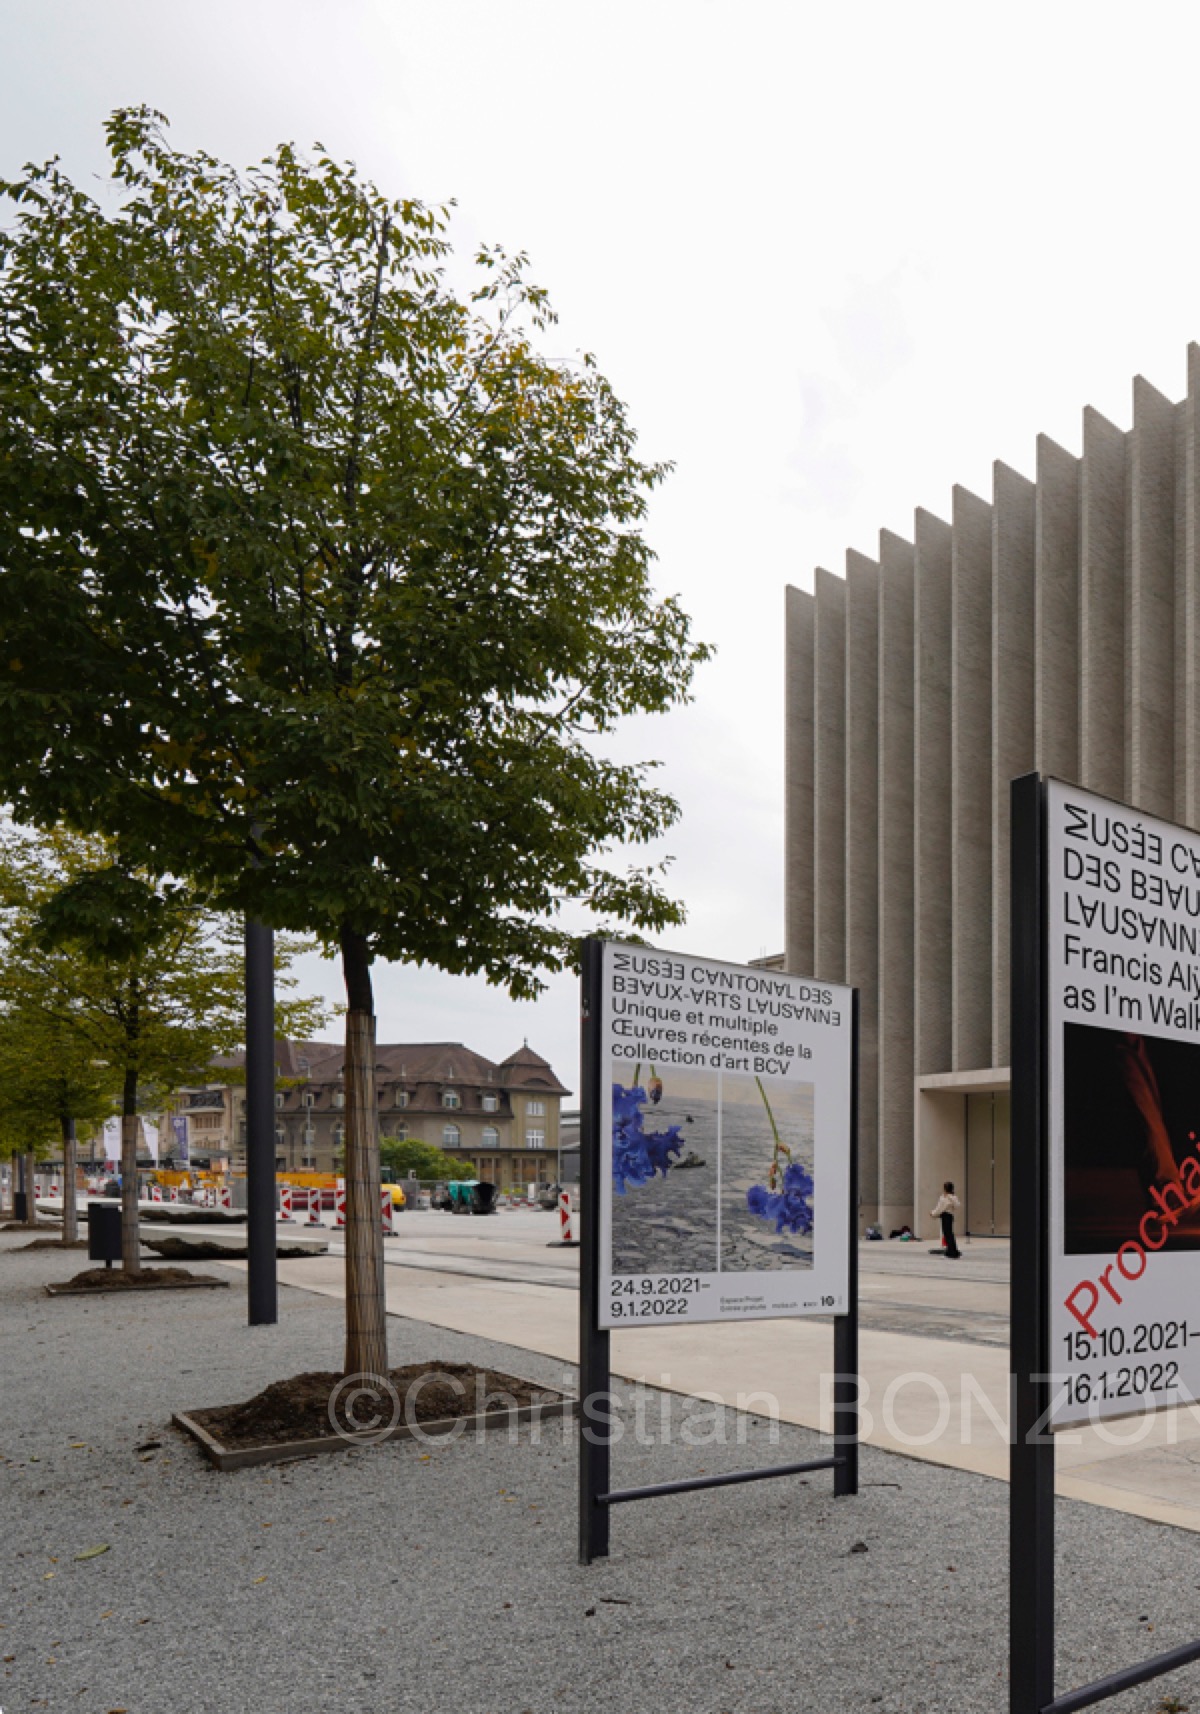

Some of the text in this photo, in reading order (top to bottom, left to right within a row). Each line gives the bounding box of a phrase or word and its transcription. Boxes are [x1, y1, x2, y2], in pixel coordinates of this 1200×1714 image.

[1064, 803, 1163, 866] MUSÉE
[1064, 847, 1121, 892] DES
[613, 952, 833, 1006] MUSÉE CANTONAL DES
[1064, 933, 1163, 986] Francis
[612, 996, 778, 1038] Unique et multiple
[613, 975, 841, 1027] BEAUX-ARTS LAUSANNE
[1063, 984, 1096, 1013] as
[611, 1042, 705, 1066] collection
[754, 1057, 790, 1075] BCV
[612, 1018, 812, 1059] Œuvres récentes de la
[610, 1298, 688, 1318] 9.1.2022
[1063, 1360, 1179, 1406] 16.1.2022
